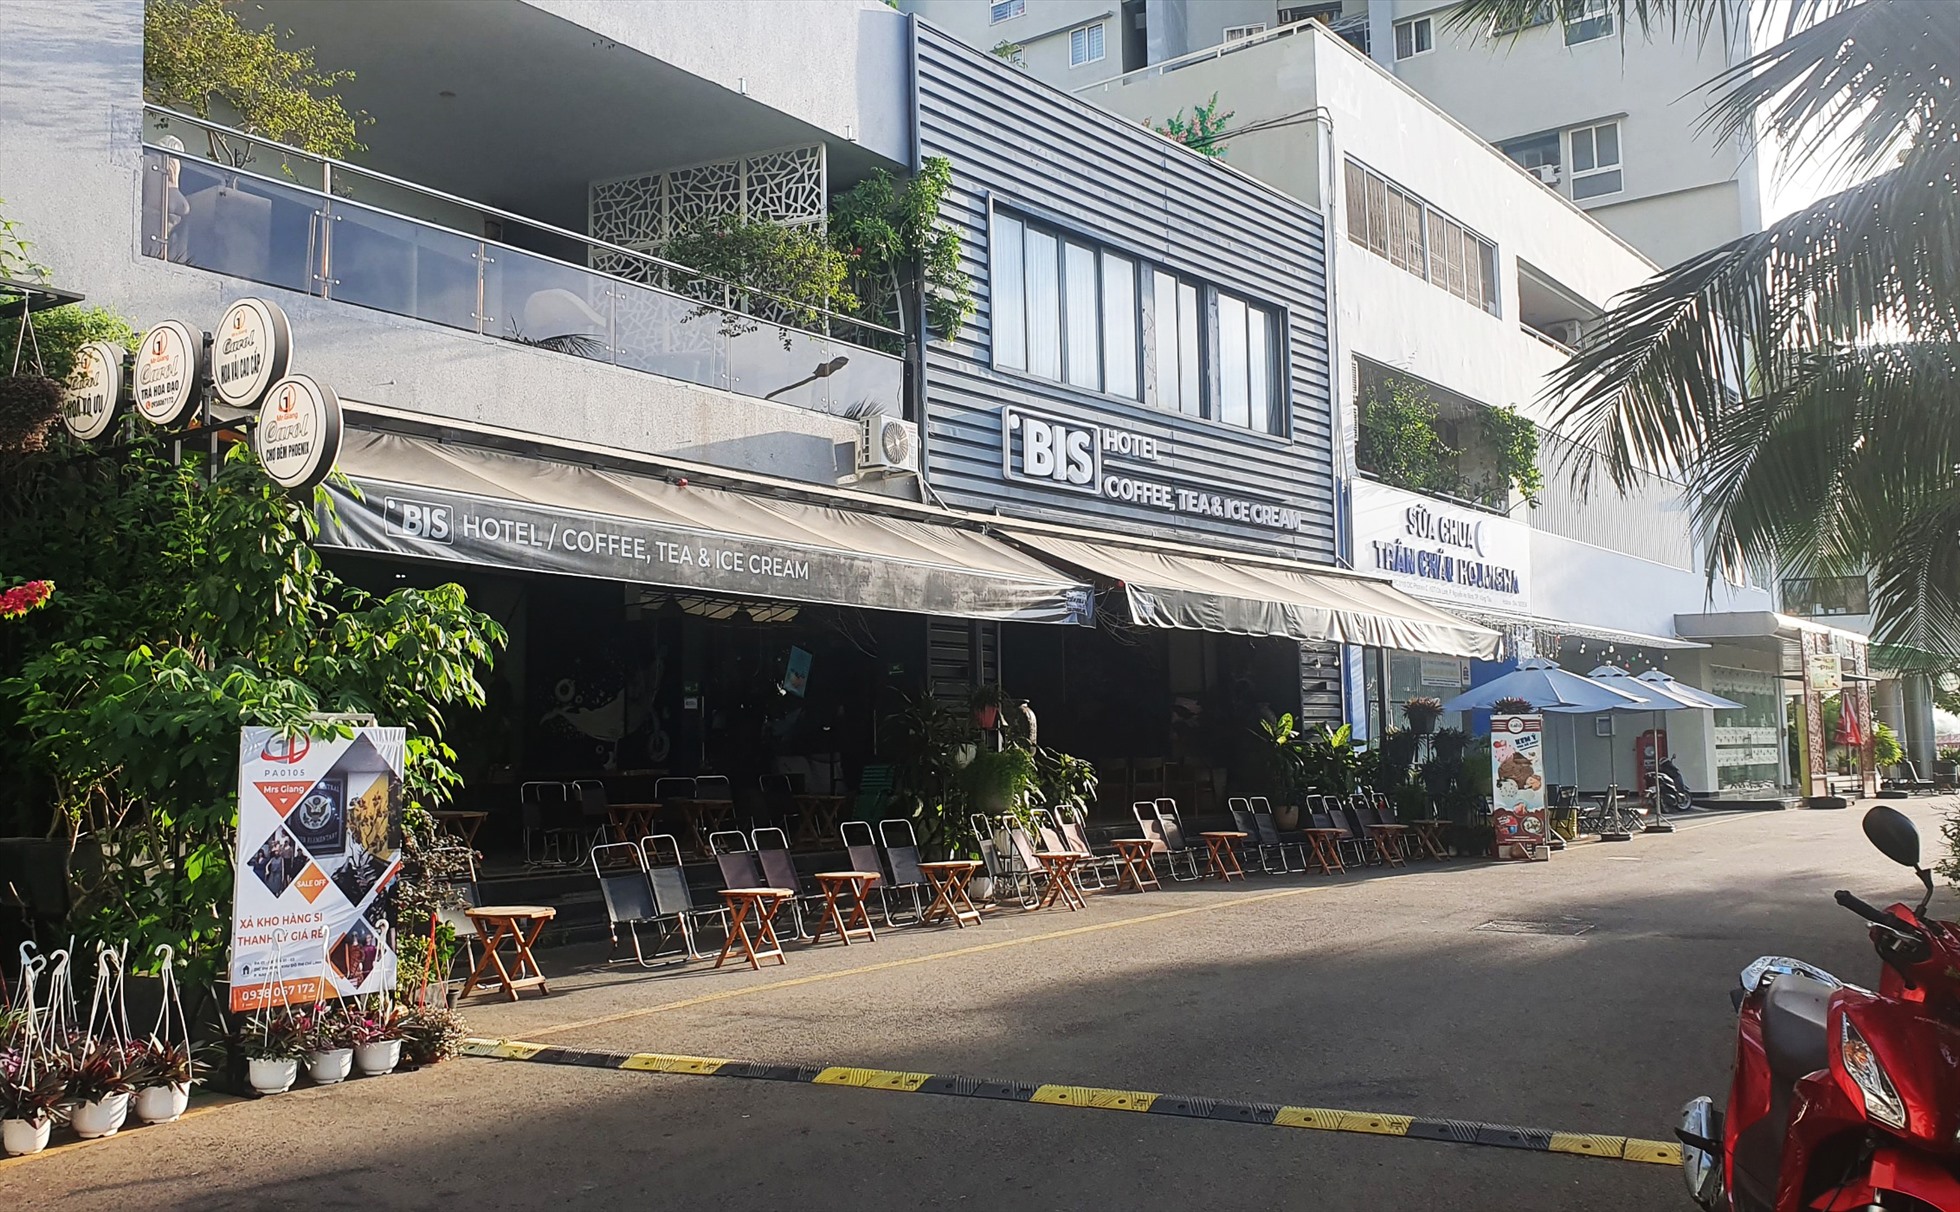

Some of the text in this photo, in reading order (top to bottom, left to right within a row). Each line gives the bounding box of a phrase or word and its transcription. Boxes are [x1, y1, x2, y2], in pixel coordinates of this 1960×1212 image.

[141, 379, 180, 401] TRÀ HOA ĐẠO
[265, 413, 309, 444] Carol
[288, 441, 309, 458] PHOENIX
[1023, 418, 1093, 484] BIS
[1103, 428, 1161, 460] HOTEL
[1104, 476, 1302, 530] COFFEE, TEA & ICE CREAM
[1406, 503, 1474, 550] SỮA CHUA
[402, 503, 449, 539] BIS
[463, 514, 542, 547] HOTEL
[562, 528, 651, 564] COFFEE,
[655, 541, 693, 566] TEA
[698, 547, 710, 568] &
[716, 549, 744, 572] ICE
[748, 554, 809, 580] CREAM
[264, 769, 305, 777] PA0105
[280, 785, 304, 794] Giang
[296, 878, 326, 888] SALE OFF
[239, 915, 254, 929] XẢ
[257, 916, 279, 928] KHO
[282, 912, 311, 925] HÀNG
[277, 929, 289, 942] LÝ
[291, 928, 309, 941] GIÁ
[242, 988, 271, 1001] 0938
[297, 983, 315, 993] 172
